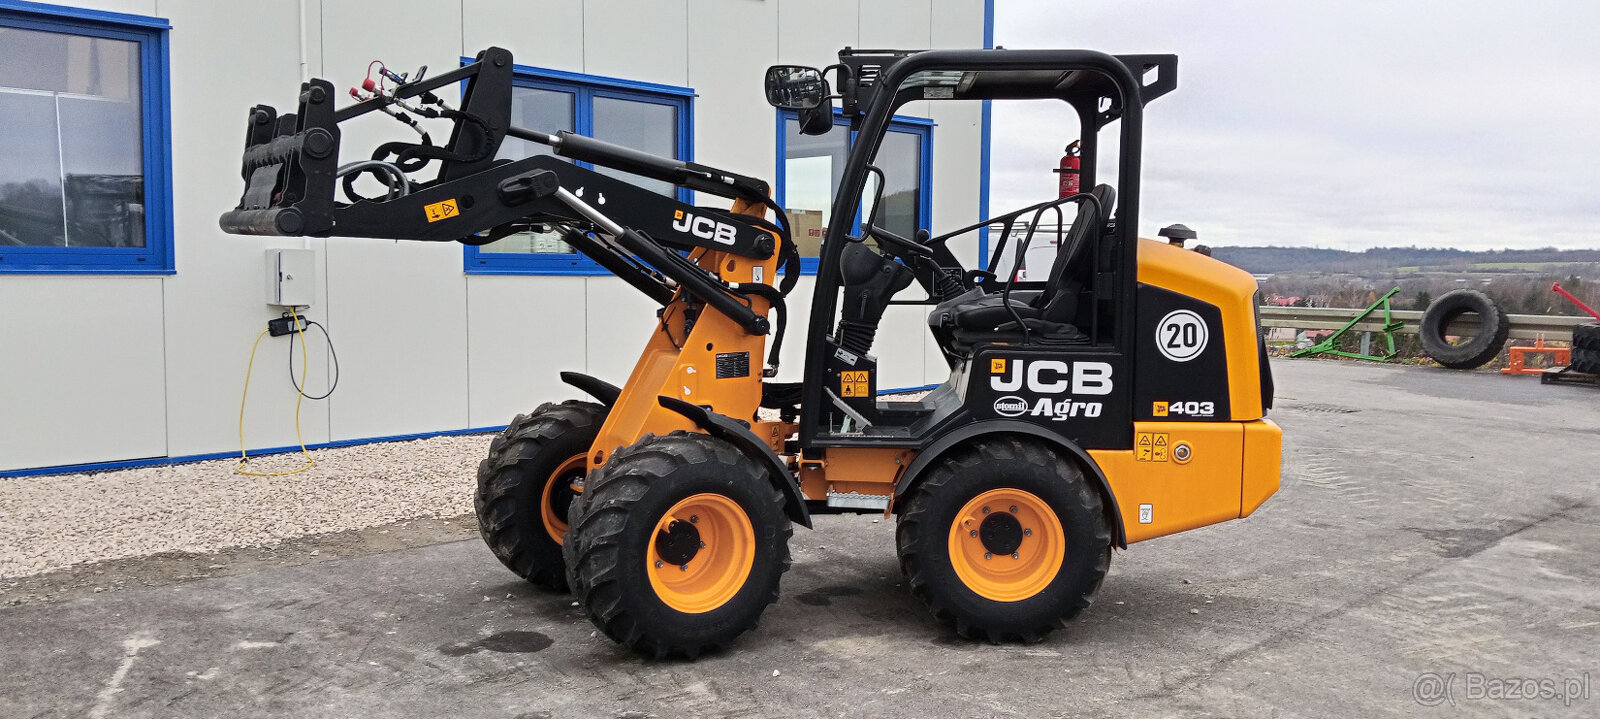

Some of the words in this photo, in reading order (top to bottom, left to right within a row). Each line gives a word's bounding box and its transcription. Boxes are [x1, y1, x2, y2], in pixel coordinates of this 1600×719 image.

[673, 213, 737, 245] JCB
[1166, 322, 1197, 348] 20
[991, 359, 1112, 395] JCB
[996, 401, 1025, 411] stomil
[1030, 398, 1102, 421] Agro
[1169, 401, 1214, 414] 403
